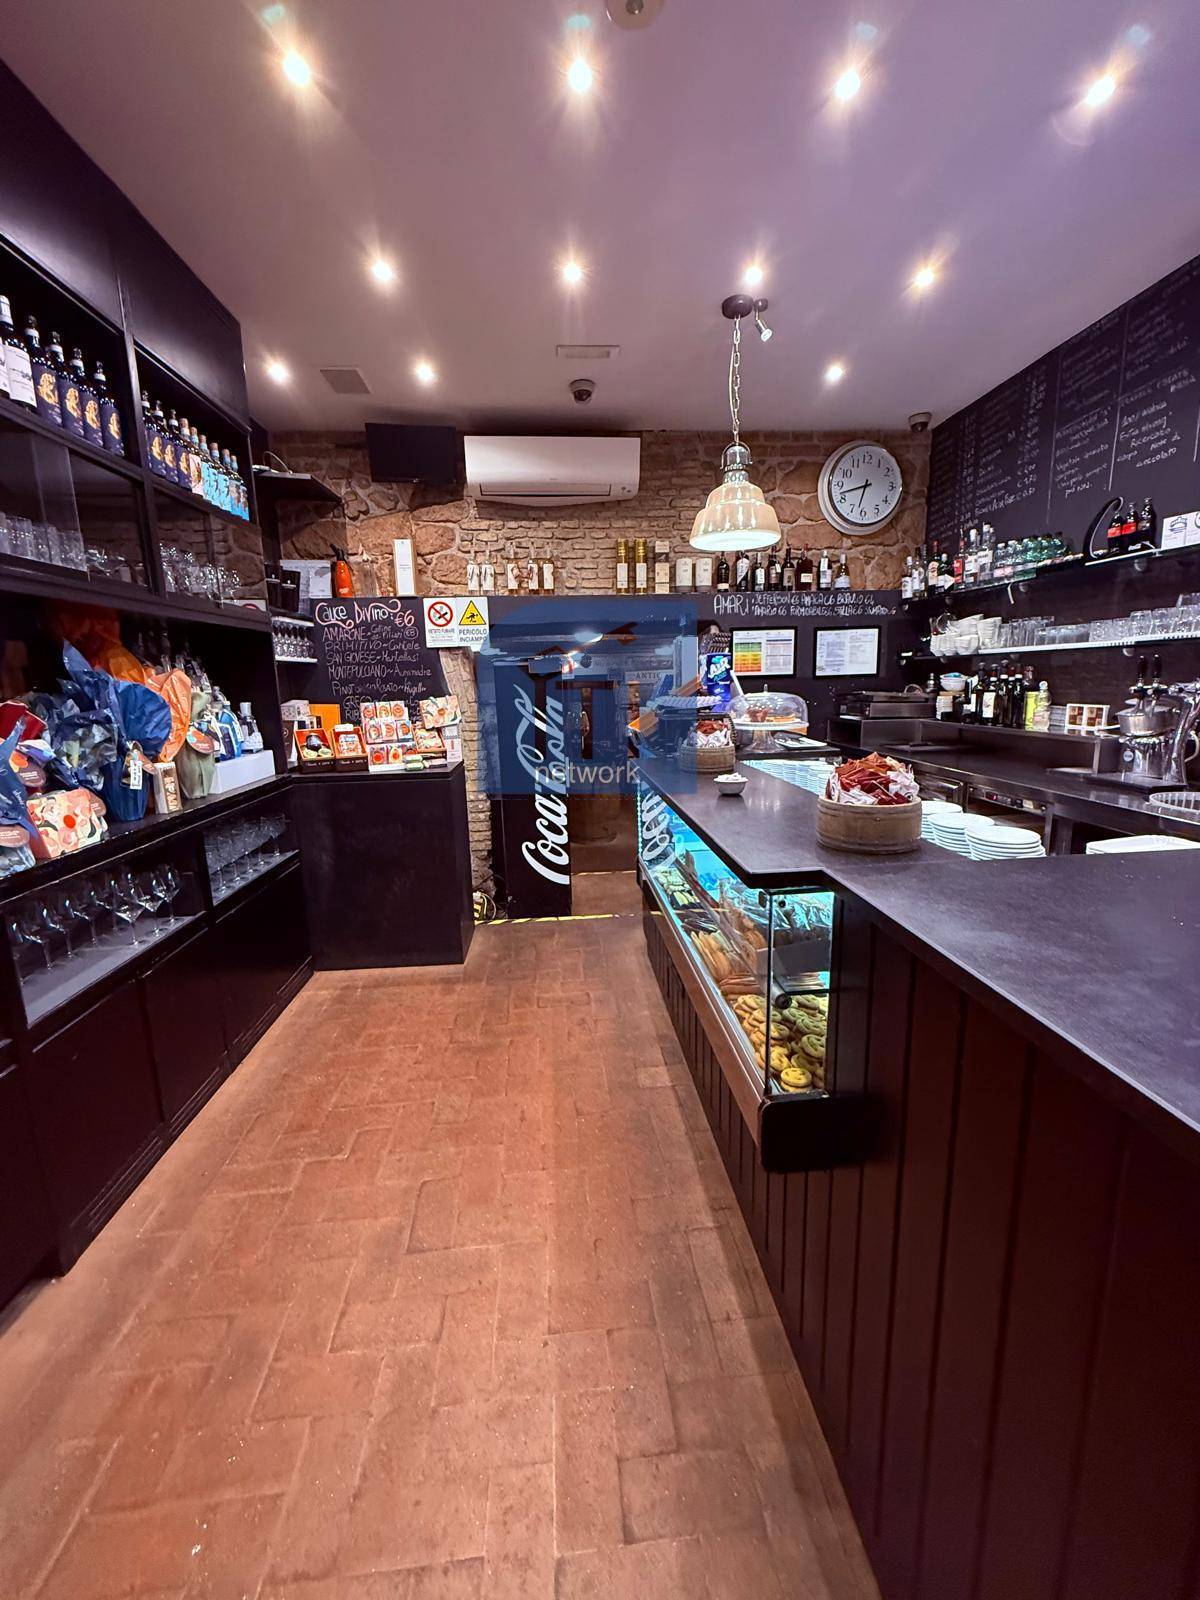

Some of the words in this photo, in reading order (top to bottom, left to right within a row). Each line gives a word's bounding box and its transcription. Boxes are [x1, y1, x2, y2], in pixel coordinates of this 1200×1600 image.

[852, 458, 860, 469] 11
[862, 454, 873, 465] 12
[877, 458, 881, 468] 1
[842, 469, 852, 479] 10
[883, 467, 890, 477] 2
[837, 481, 844, 491] 9
[888, 481, 894, 491] 3
[840, 494, 847, 504] 8
[882, 495, 888, 504] 4
[850, 503, 856, 514] 7
[860, 507, 867, 518] 6
[874, 504, 880, 516] 5
[713, 594, 749, 616] AMARI
[324, 641, 381, 652] PRIMITIVO
